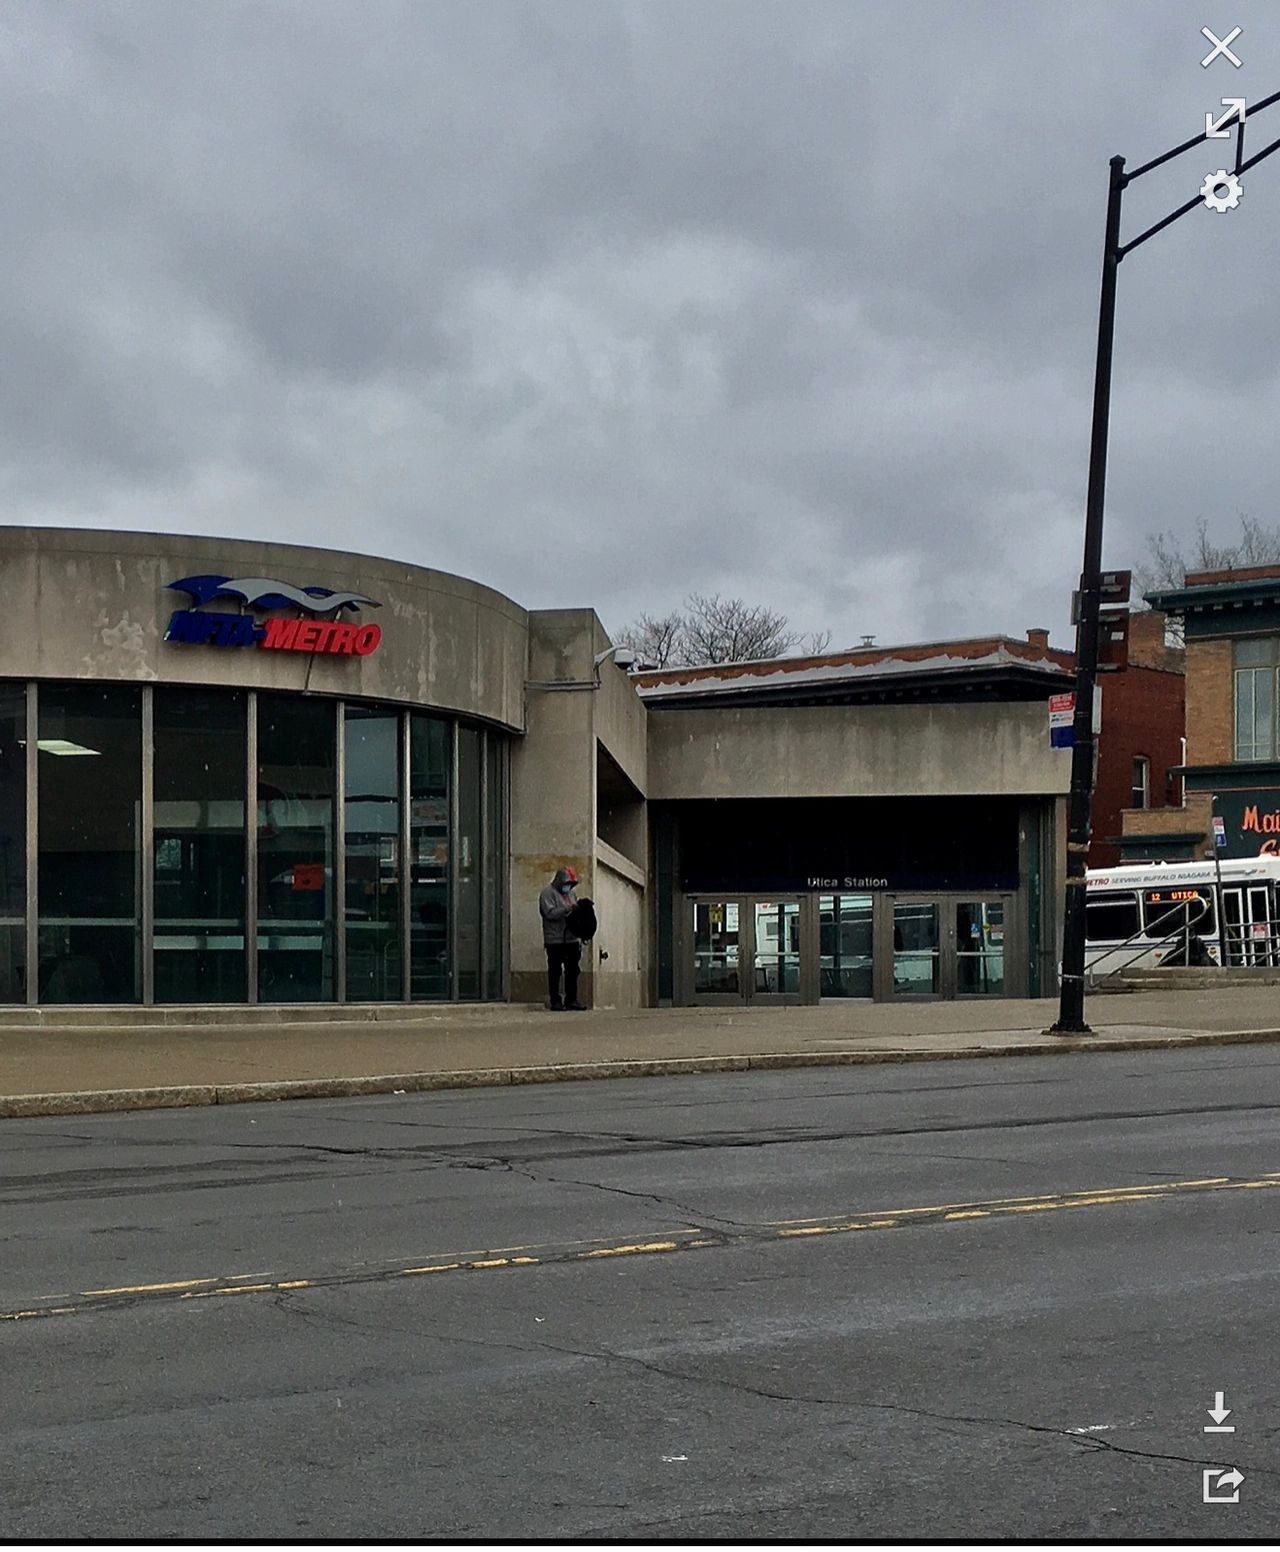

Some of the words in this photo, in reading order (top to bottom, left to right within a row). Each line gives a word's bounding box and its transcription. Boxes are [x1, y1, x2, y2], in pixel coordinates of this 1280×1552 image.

[807, 877, 838, 888] Utica
[844, 876, 888, 888] Station
[1087, 877, 1110, 886] ETRO
[1143, 874, 1177, 882] BUFFALO
[1177, 871, 1211, 880] NIAGARA
[1151, 892, 1161, 901] 12
[1171, 890, 1199, 901] UTICA
